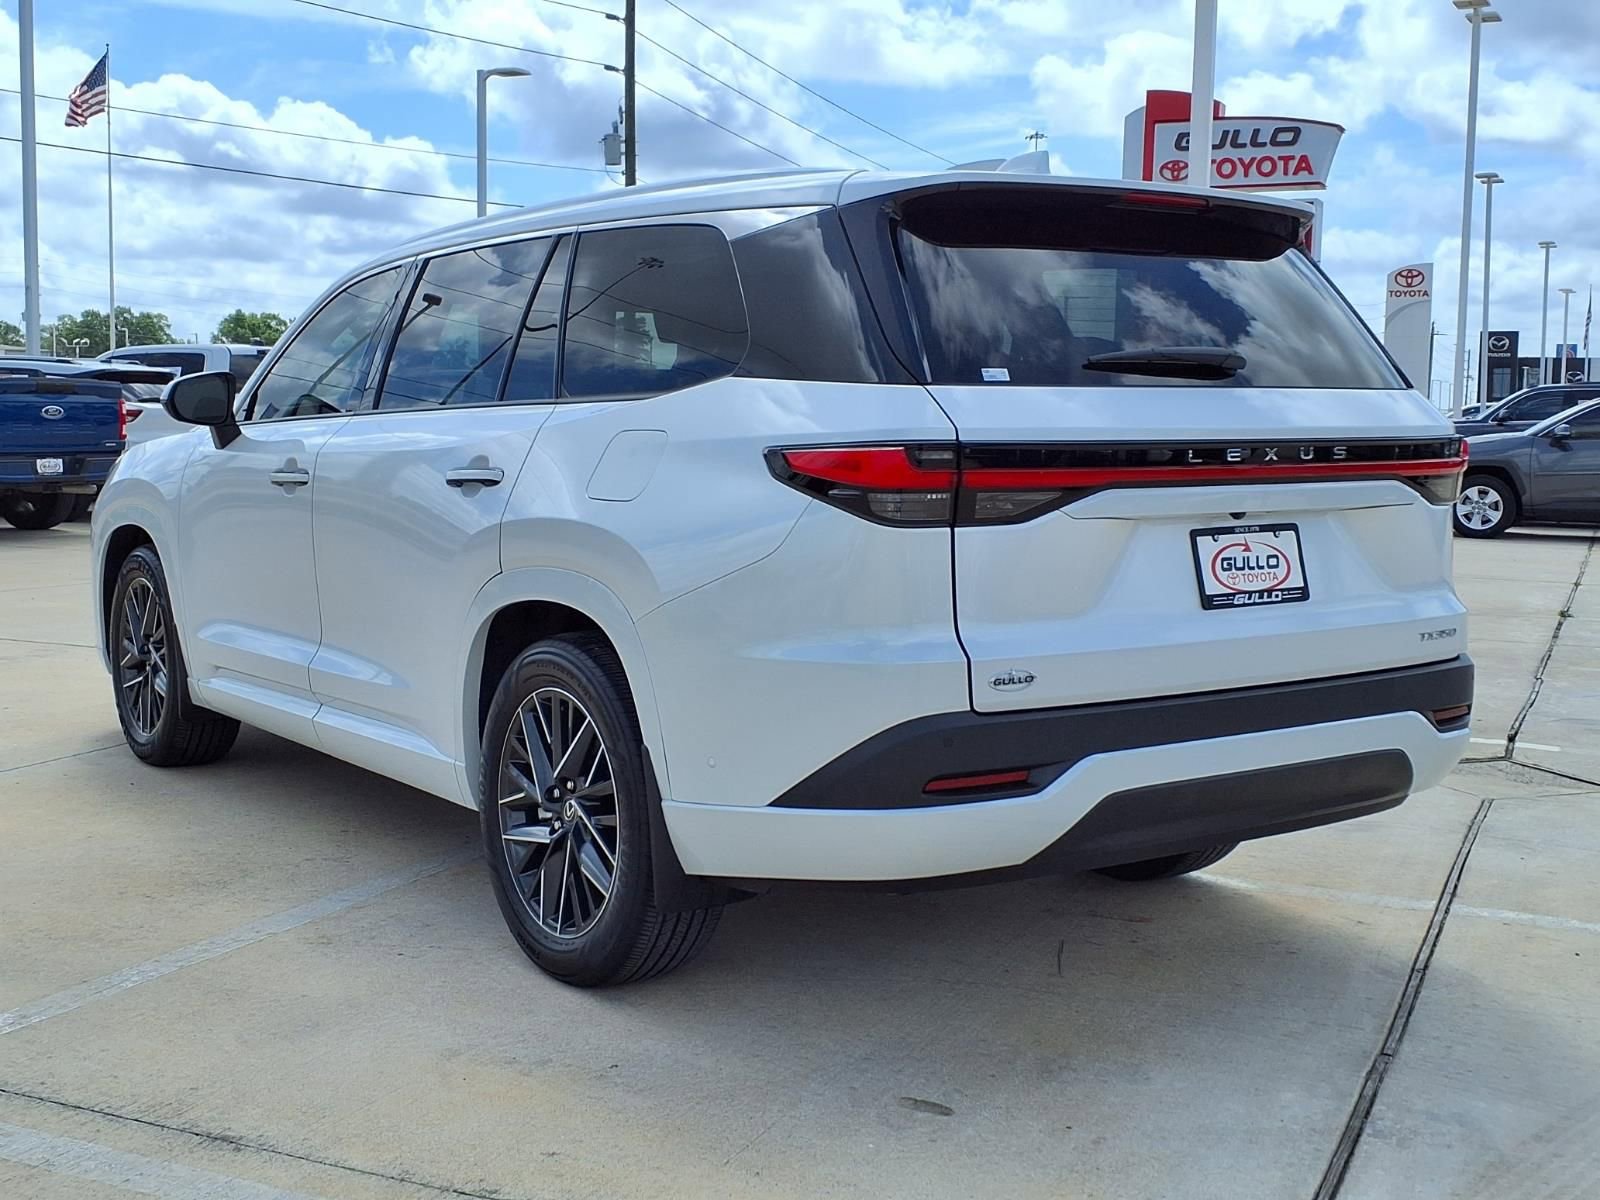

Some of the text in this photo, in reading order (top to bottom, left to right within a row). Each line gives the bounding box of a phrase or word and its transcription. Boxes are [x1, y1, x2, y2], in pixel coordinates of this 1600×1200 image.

[1211, 154, 1314, 179] OYOTA
[1388, 289, 1429, 298] TOYOTA
[1188, 446, 1347, 462] LEXUS
[1221, 554, 1279, 572] GULLO
[1241, 572, 1279, 583] TOYOTA
[1233, 591, 1282, 604] GULLO
[993, 675, 1034, 686] GULLO
